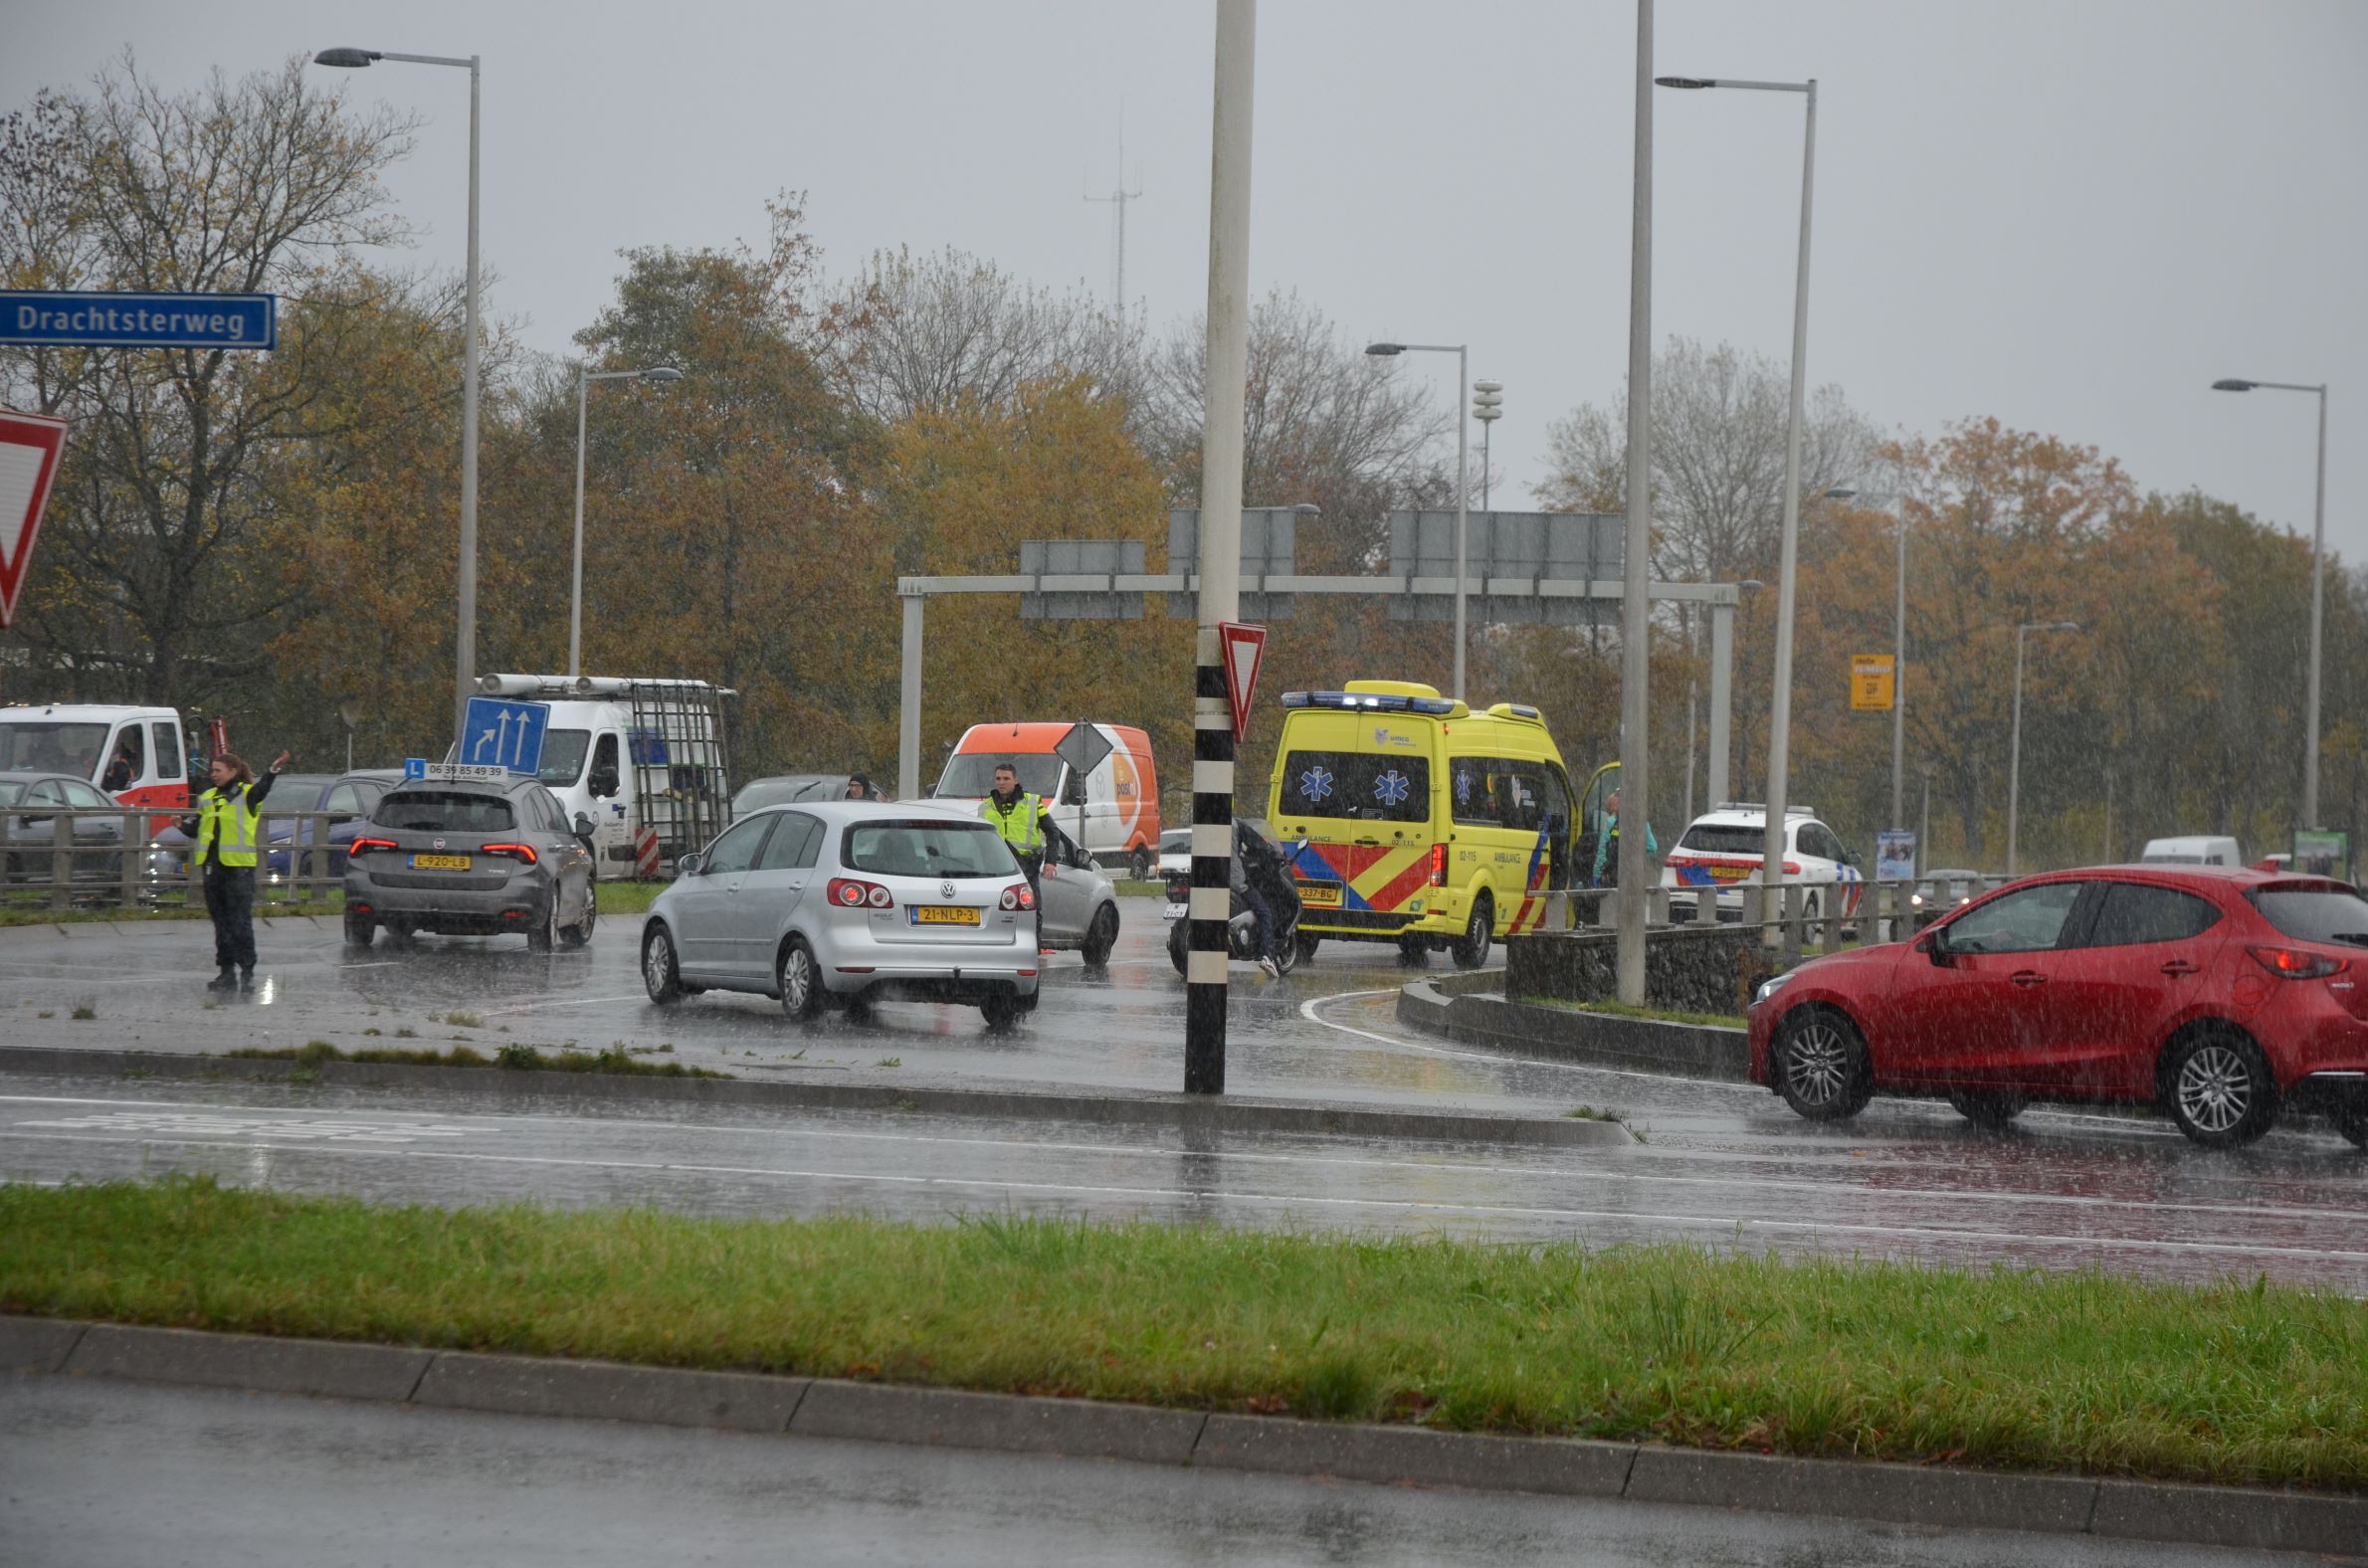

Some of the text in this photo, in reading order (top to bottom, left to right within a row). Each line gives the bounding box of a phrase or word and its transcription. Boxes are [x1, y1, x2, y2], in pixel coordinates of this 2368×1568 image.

[18, 305, 245, 340] Drachtsterweg
[410, 762, 420, 775] L
[429, 765, 442, 774] 06
[445, 765, 457, 775] 39
[460, 766, 472, 775] 85
[474, 767, 487, 776] 49
[1460, 851, 1477, 862] 02-115
[1494, 852, 1521, 864] AMBULANCE
[923, 908, 974, 921] 21-NLP-3
